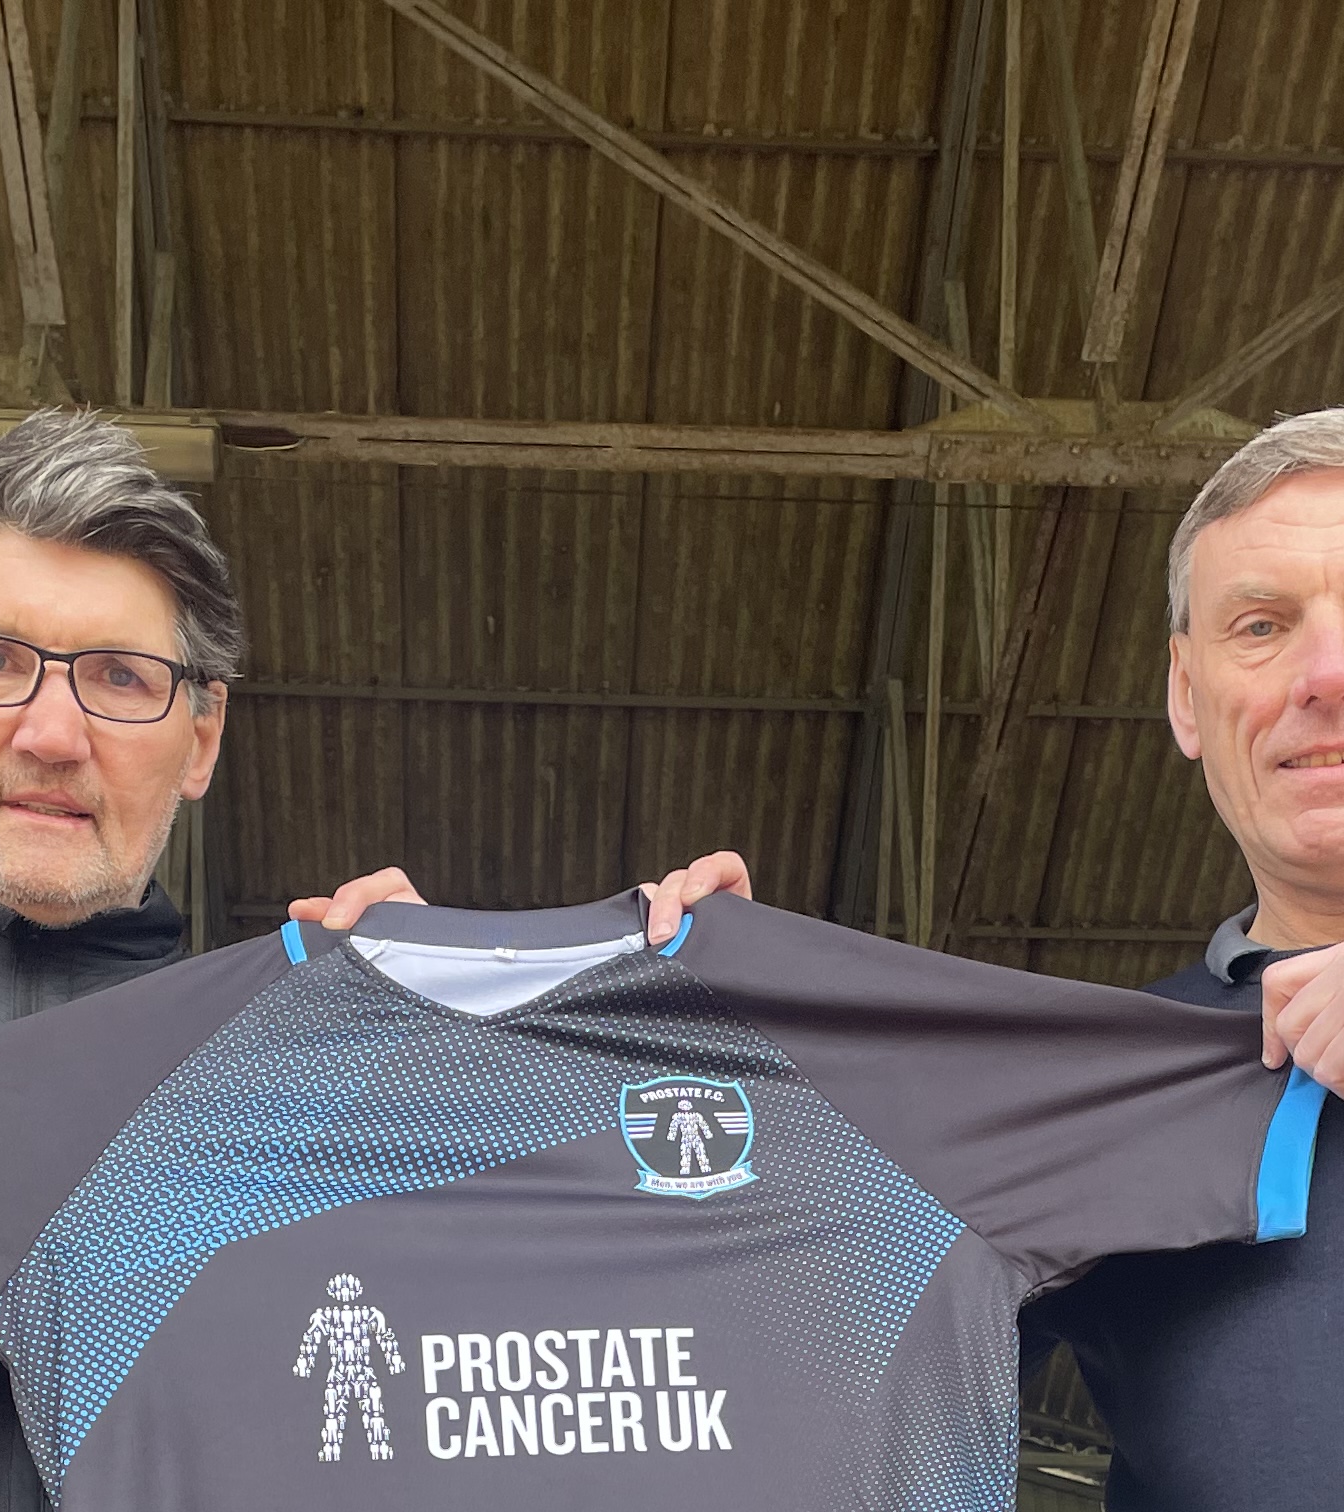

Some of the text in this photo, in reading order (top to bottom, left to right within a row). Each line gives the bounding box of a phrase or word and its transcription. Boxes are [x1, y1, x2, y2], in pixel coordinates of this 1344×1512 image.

[639, 1087, 725, 1103] PROSTATE F.C.
[675, 1181, 688, 1189] we
[690, 1181, 704, 1189] are
[706, 1175, 725, 1188] with
[727, 1172, 743, 1184] you
[420, 1328, 697, 1394] PROSTATE
[425, 1390, 733, 1460] CANCER UK
